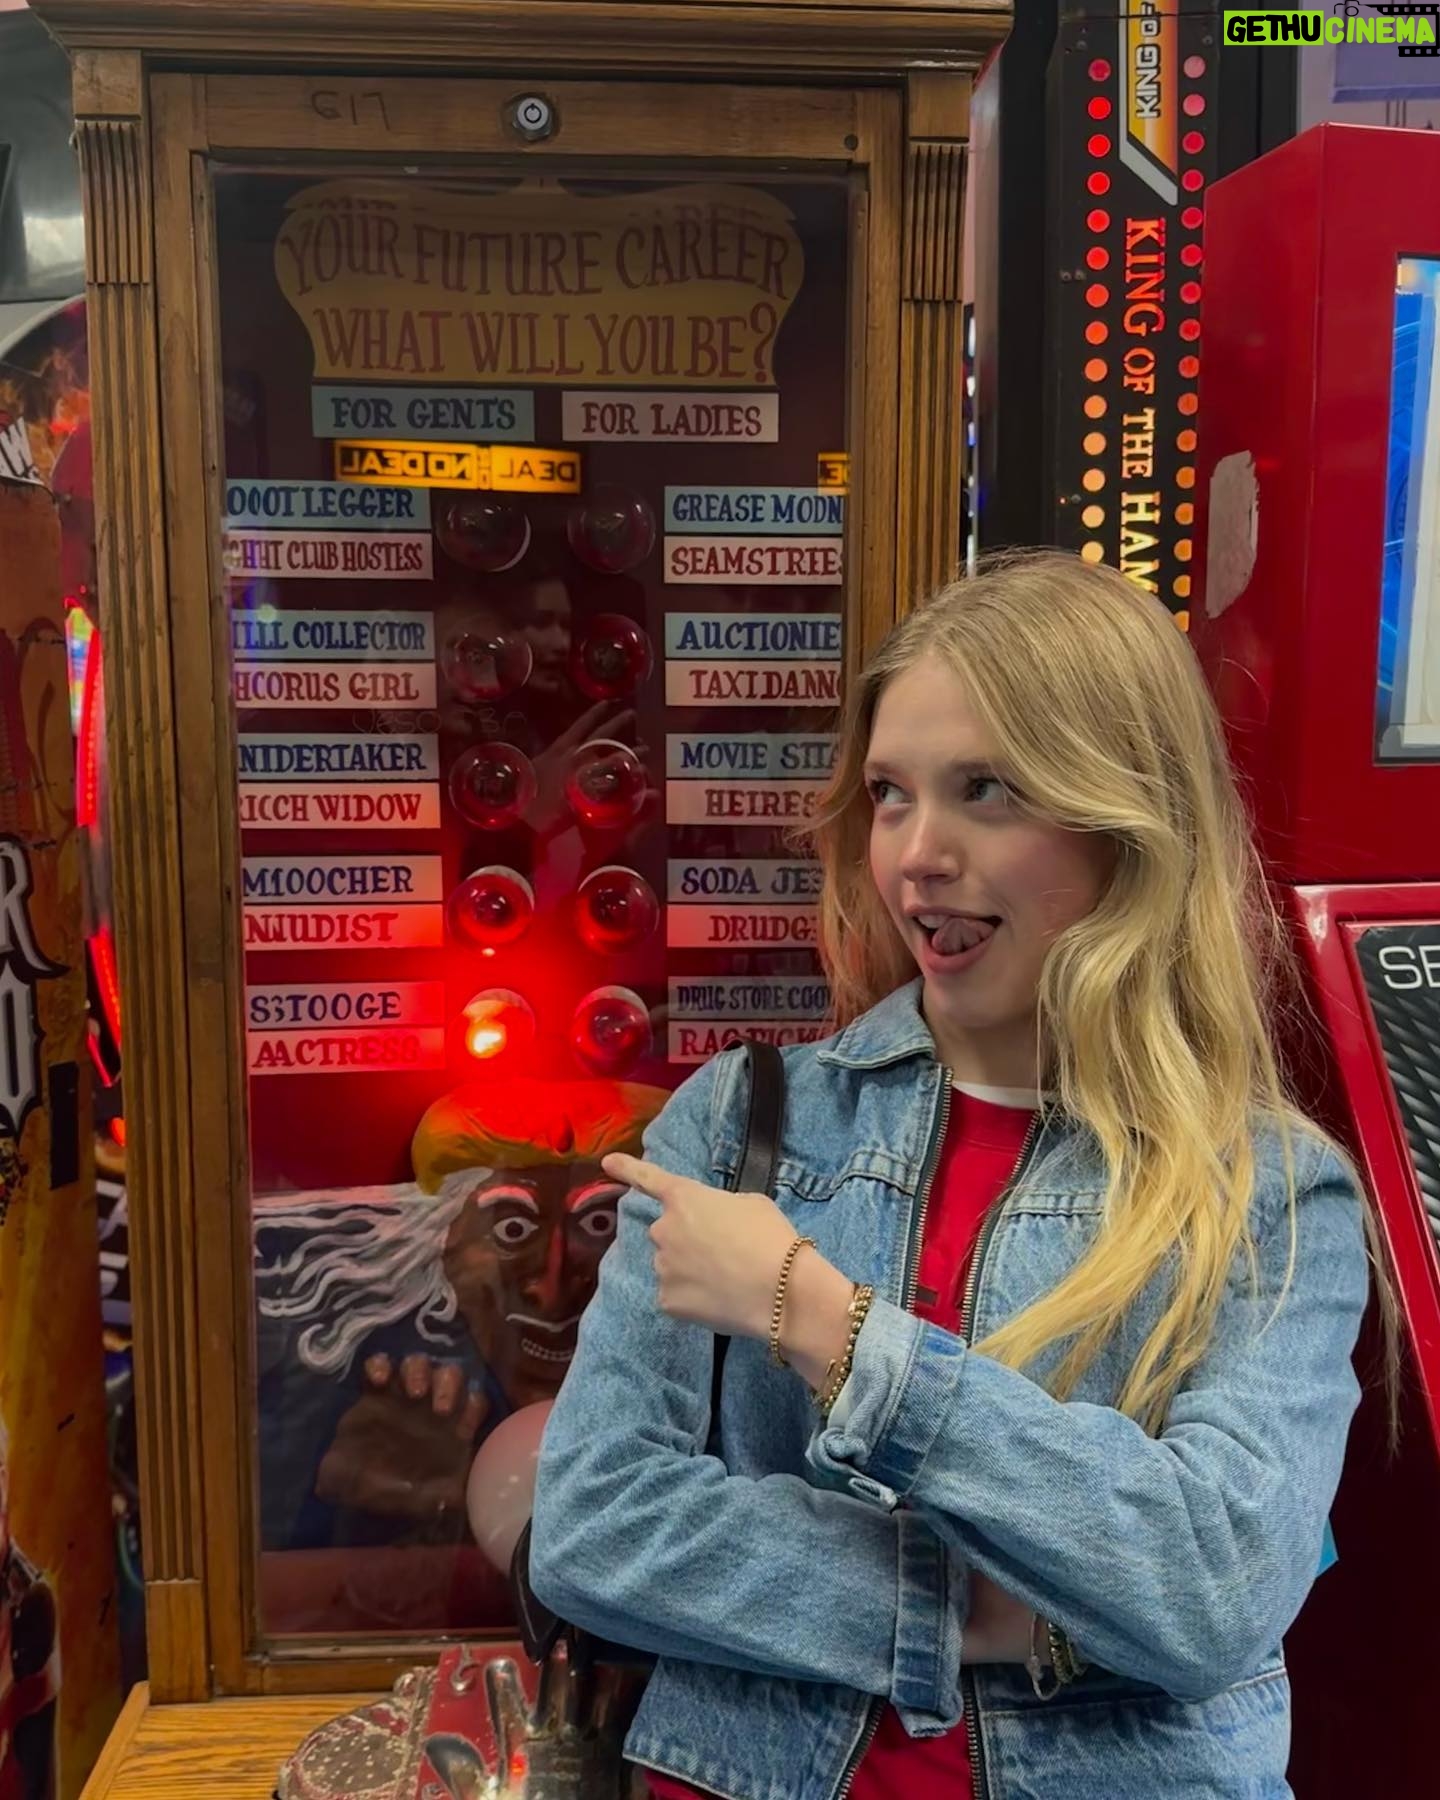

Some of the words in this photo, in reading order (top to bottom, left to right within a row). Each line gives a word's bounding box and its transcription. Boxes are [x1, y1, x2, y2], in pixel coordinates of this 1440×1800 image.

[1135, 43, 1161, 118] KING
[280, 199, 404, 296] YOUR
[413, 222, 602, 297] FUTURE
[615, 205, 791, 300] CAREER
[1123, 217, 1166, 337] KING
[312, 307, 453, 374] WHAT
[460, 309, 585, 376] WILL
[584, 313, 679, 377] YOU
[683, 301, 778, 384] BE?
[1122, 347, 1156, 395] OF
[331, 396, 397, 430] FOR
[581, 402, 639, 435] FOR
[651, 403, 762, 436] LADIES
[1121, 408, 1156, 479] THE
[672, 494, 766, 523] GREASE
[287, 541, 339, 570] CLUB
[341, 541, 423, 572] HOSTESS
[293, 621, 425, 650] COLLECTOR
[348, 672, 419, 701] GIRL
[689, 670, 758, 699] TAXI
[680, 742, 768, 769] MOVIE
[312, 793, 421, 822] WIDOW
[681, 867, 761, 895] SODA
[708, 915, 817, 941] DRUDG
[677, 985, 725, 1012] DRUG
[729, 985, 784, 1011] STORE
